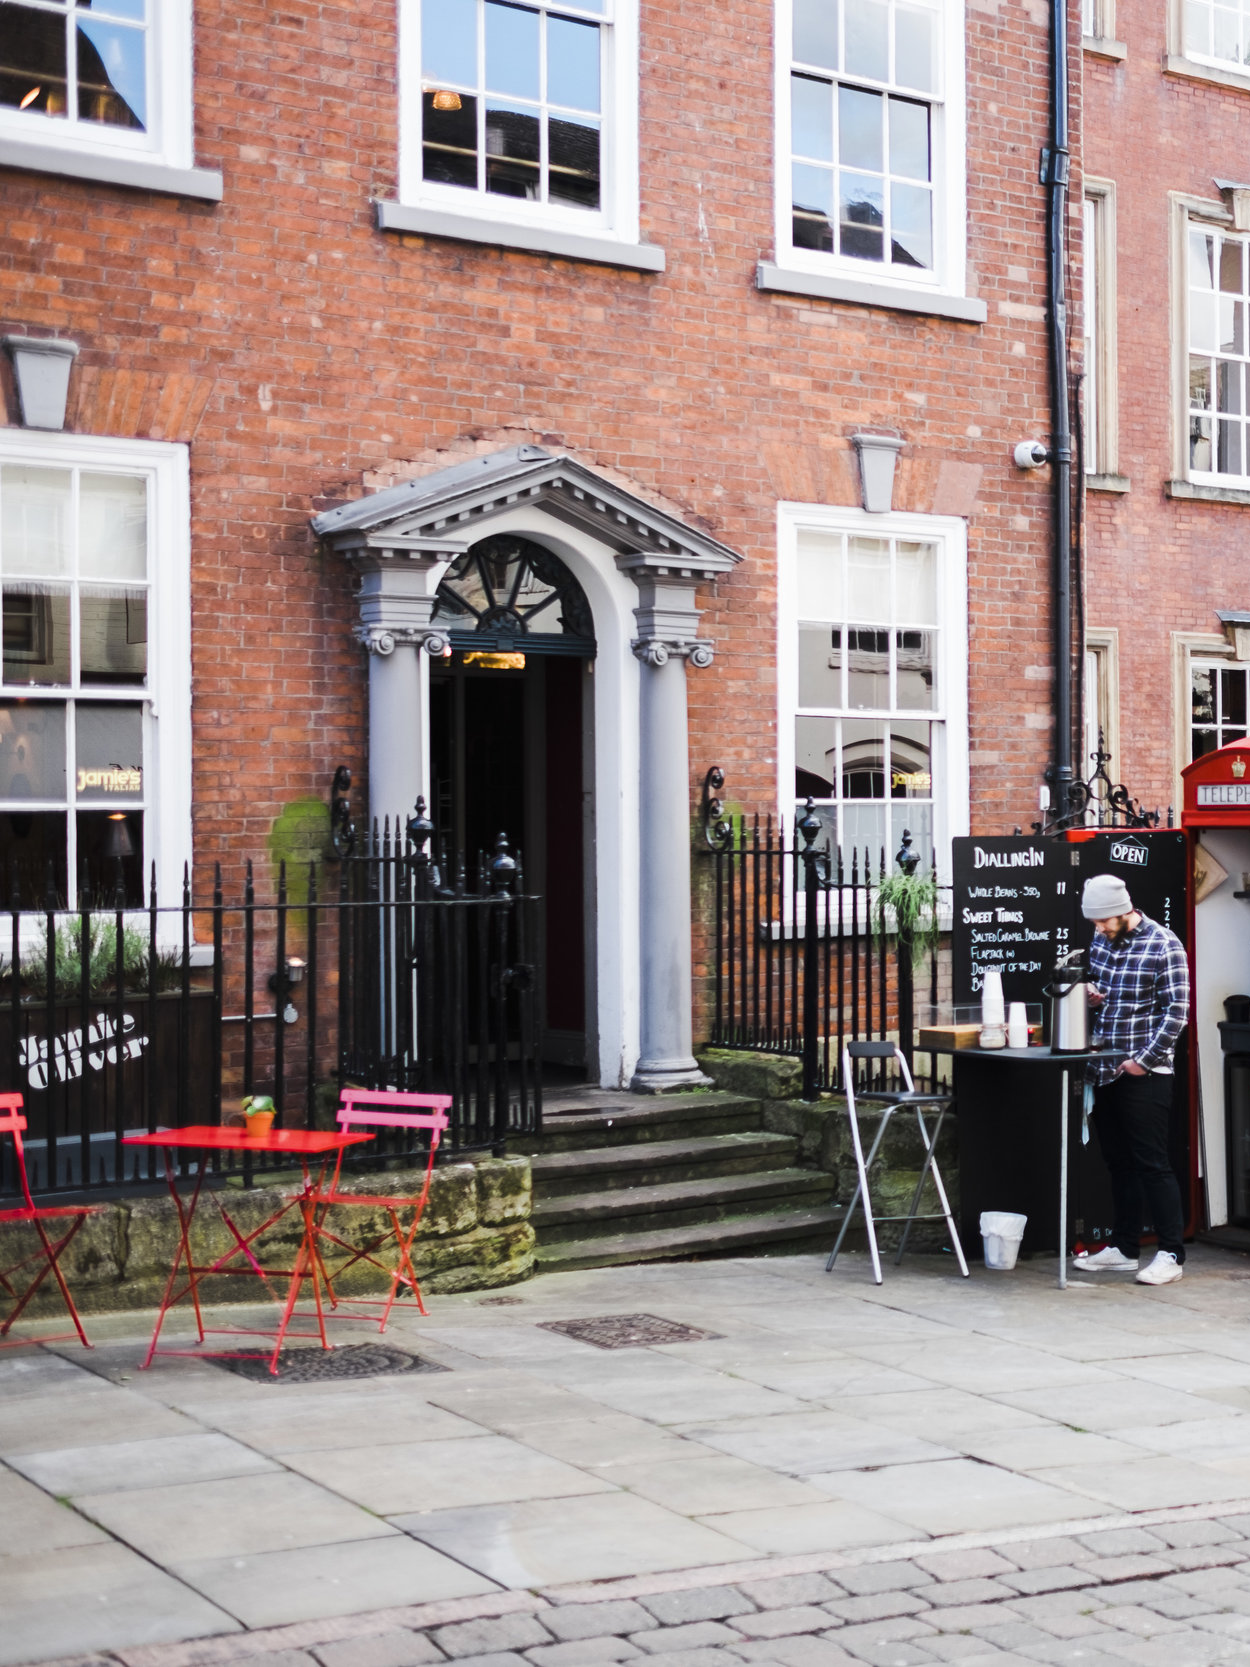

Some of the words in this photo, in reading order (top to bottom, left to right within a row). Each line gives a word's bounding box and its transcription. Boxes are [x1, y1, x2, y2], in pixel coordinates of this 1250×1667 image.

[77, 768, 141, 792] jamie's
[104, 784, 140, 792] ITALIAN
[1112, 845, 1145, 864] OPEN
[968, 886, 993, 898] WHOLE
[994, 886, 1018, 898] BEANS
[1164, 897, 1171, 908] 2
[962, 907, 993, 924] SWEET
[1164, 910, 1171, 921] 2
[971, 928, 997, 944] SALTED
[997, 928, 1024, 942] CARAMEL
[970, 945, 1004, 960] FLAPJACK
[1008, 963, 1018, 973] OF
[1018, 962, 1029, 971] THE
[1028, 960, 1042, 973] DAY
[19, 1012, 136, 1066] Jamie
[27, 1035, 150, 1090] Oliver
